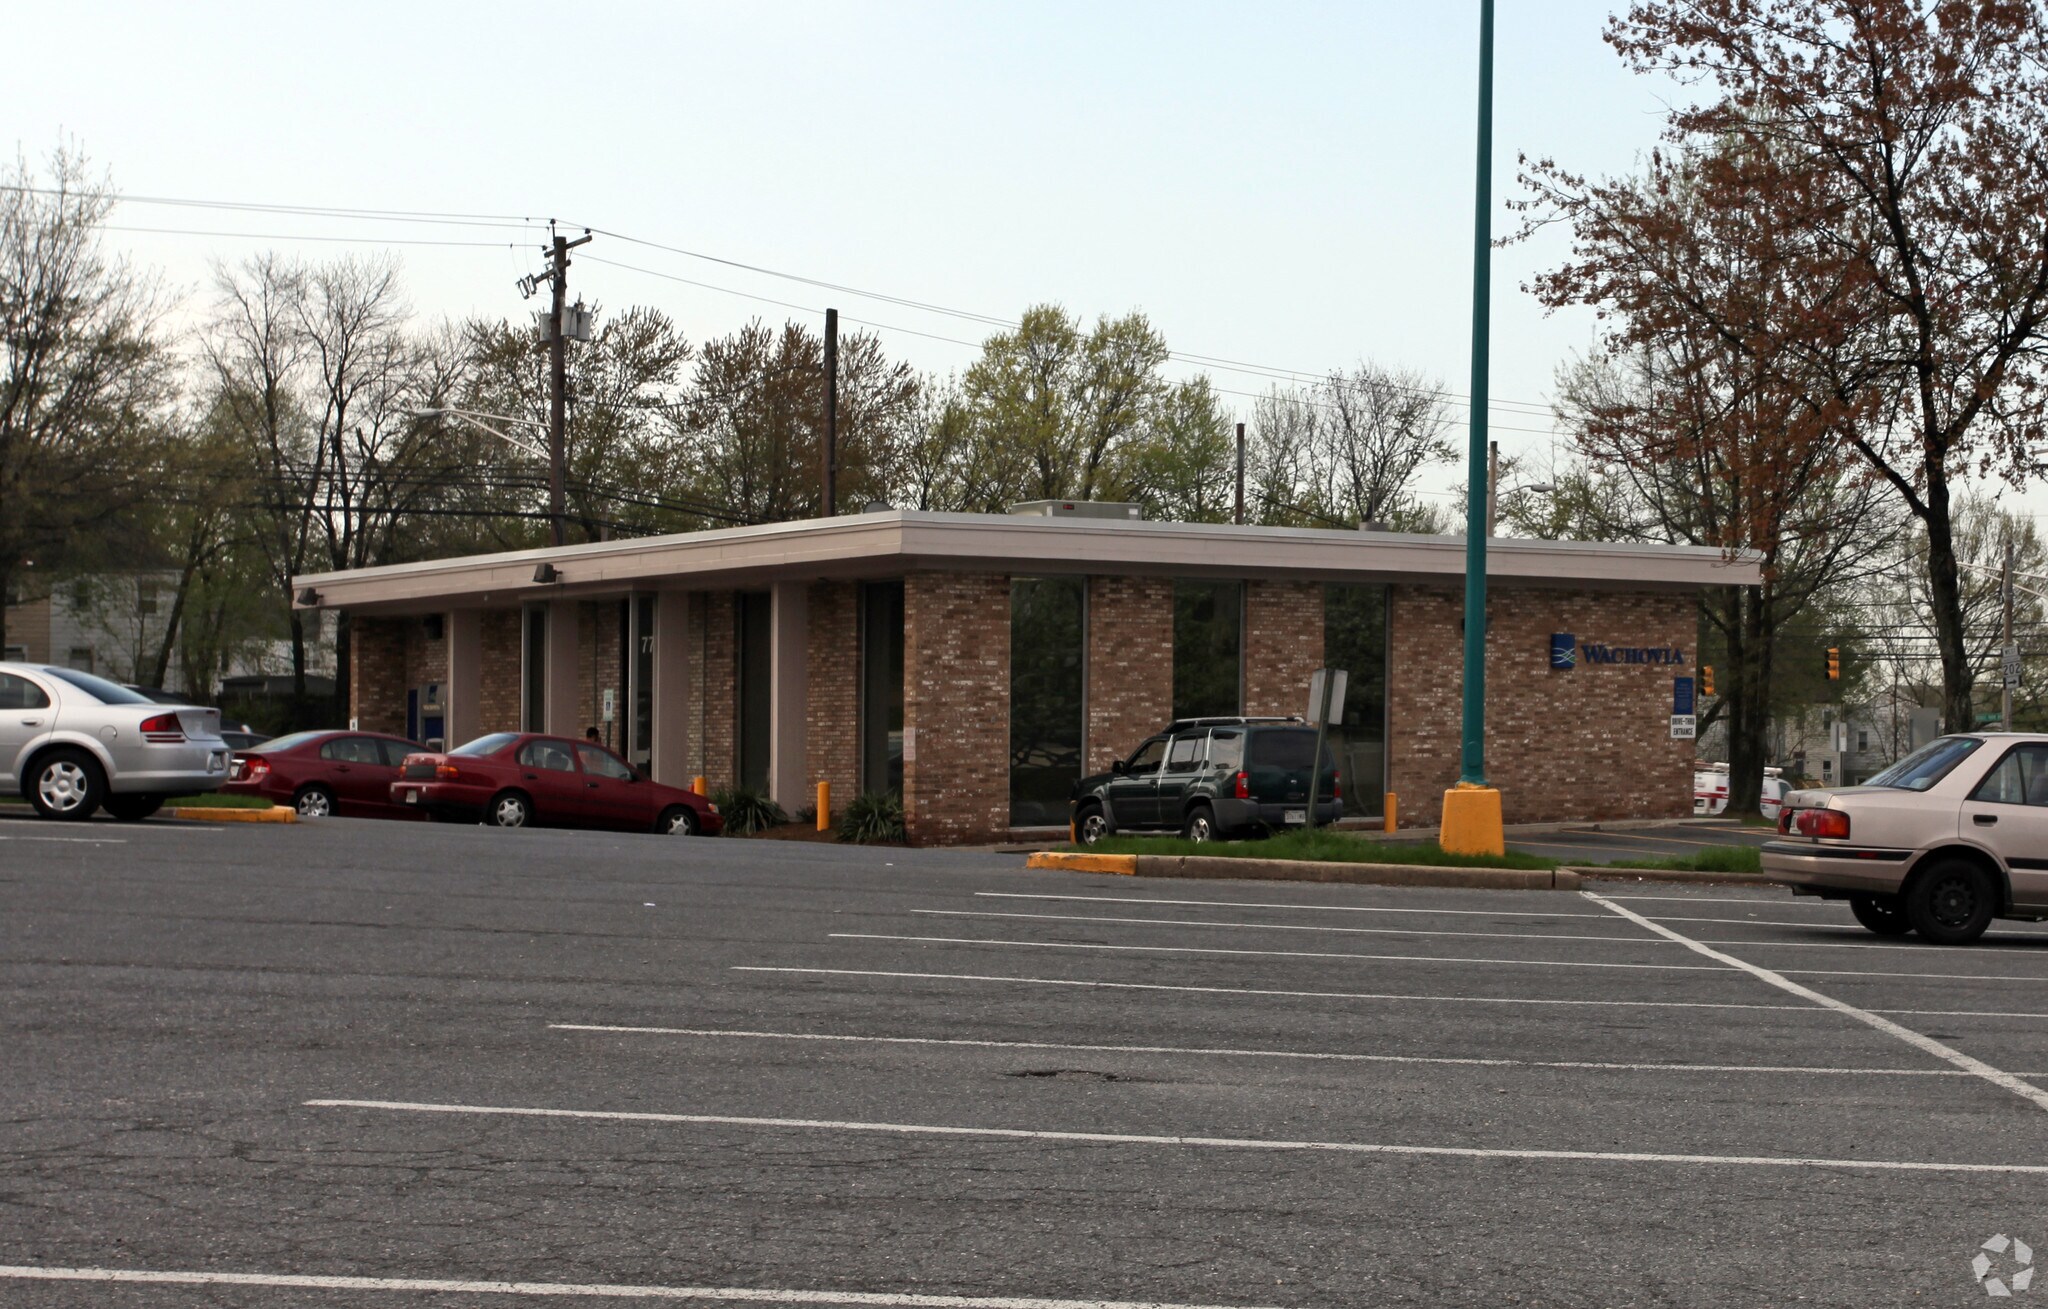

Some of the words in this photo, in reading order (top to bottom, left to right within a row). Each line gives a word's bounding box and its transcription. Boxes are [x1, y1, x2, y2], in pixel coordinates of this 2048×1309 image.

[1582, 645, 1684, 665] WACHOVIA
[2003, 663, 2021, 675] 202
[1672, 717, 1695, 725] DRIVE-THRU
